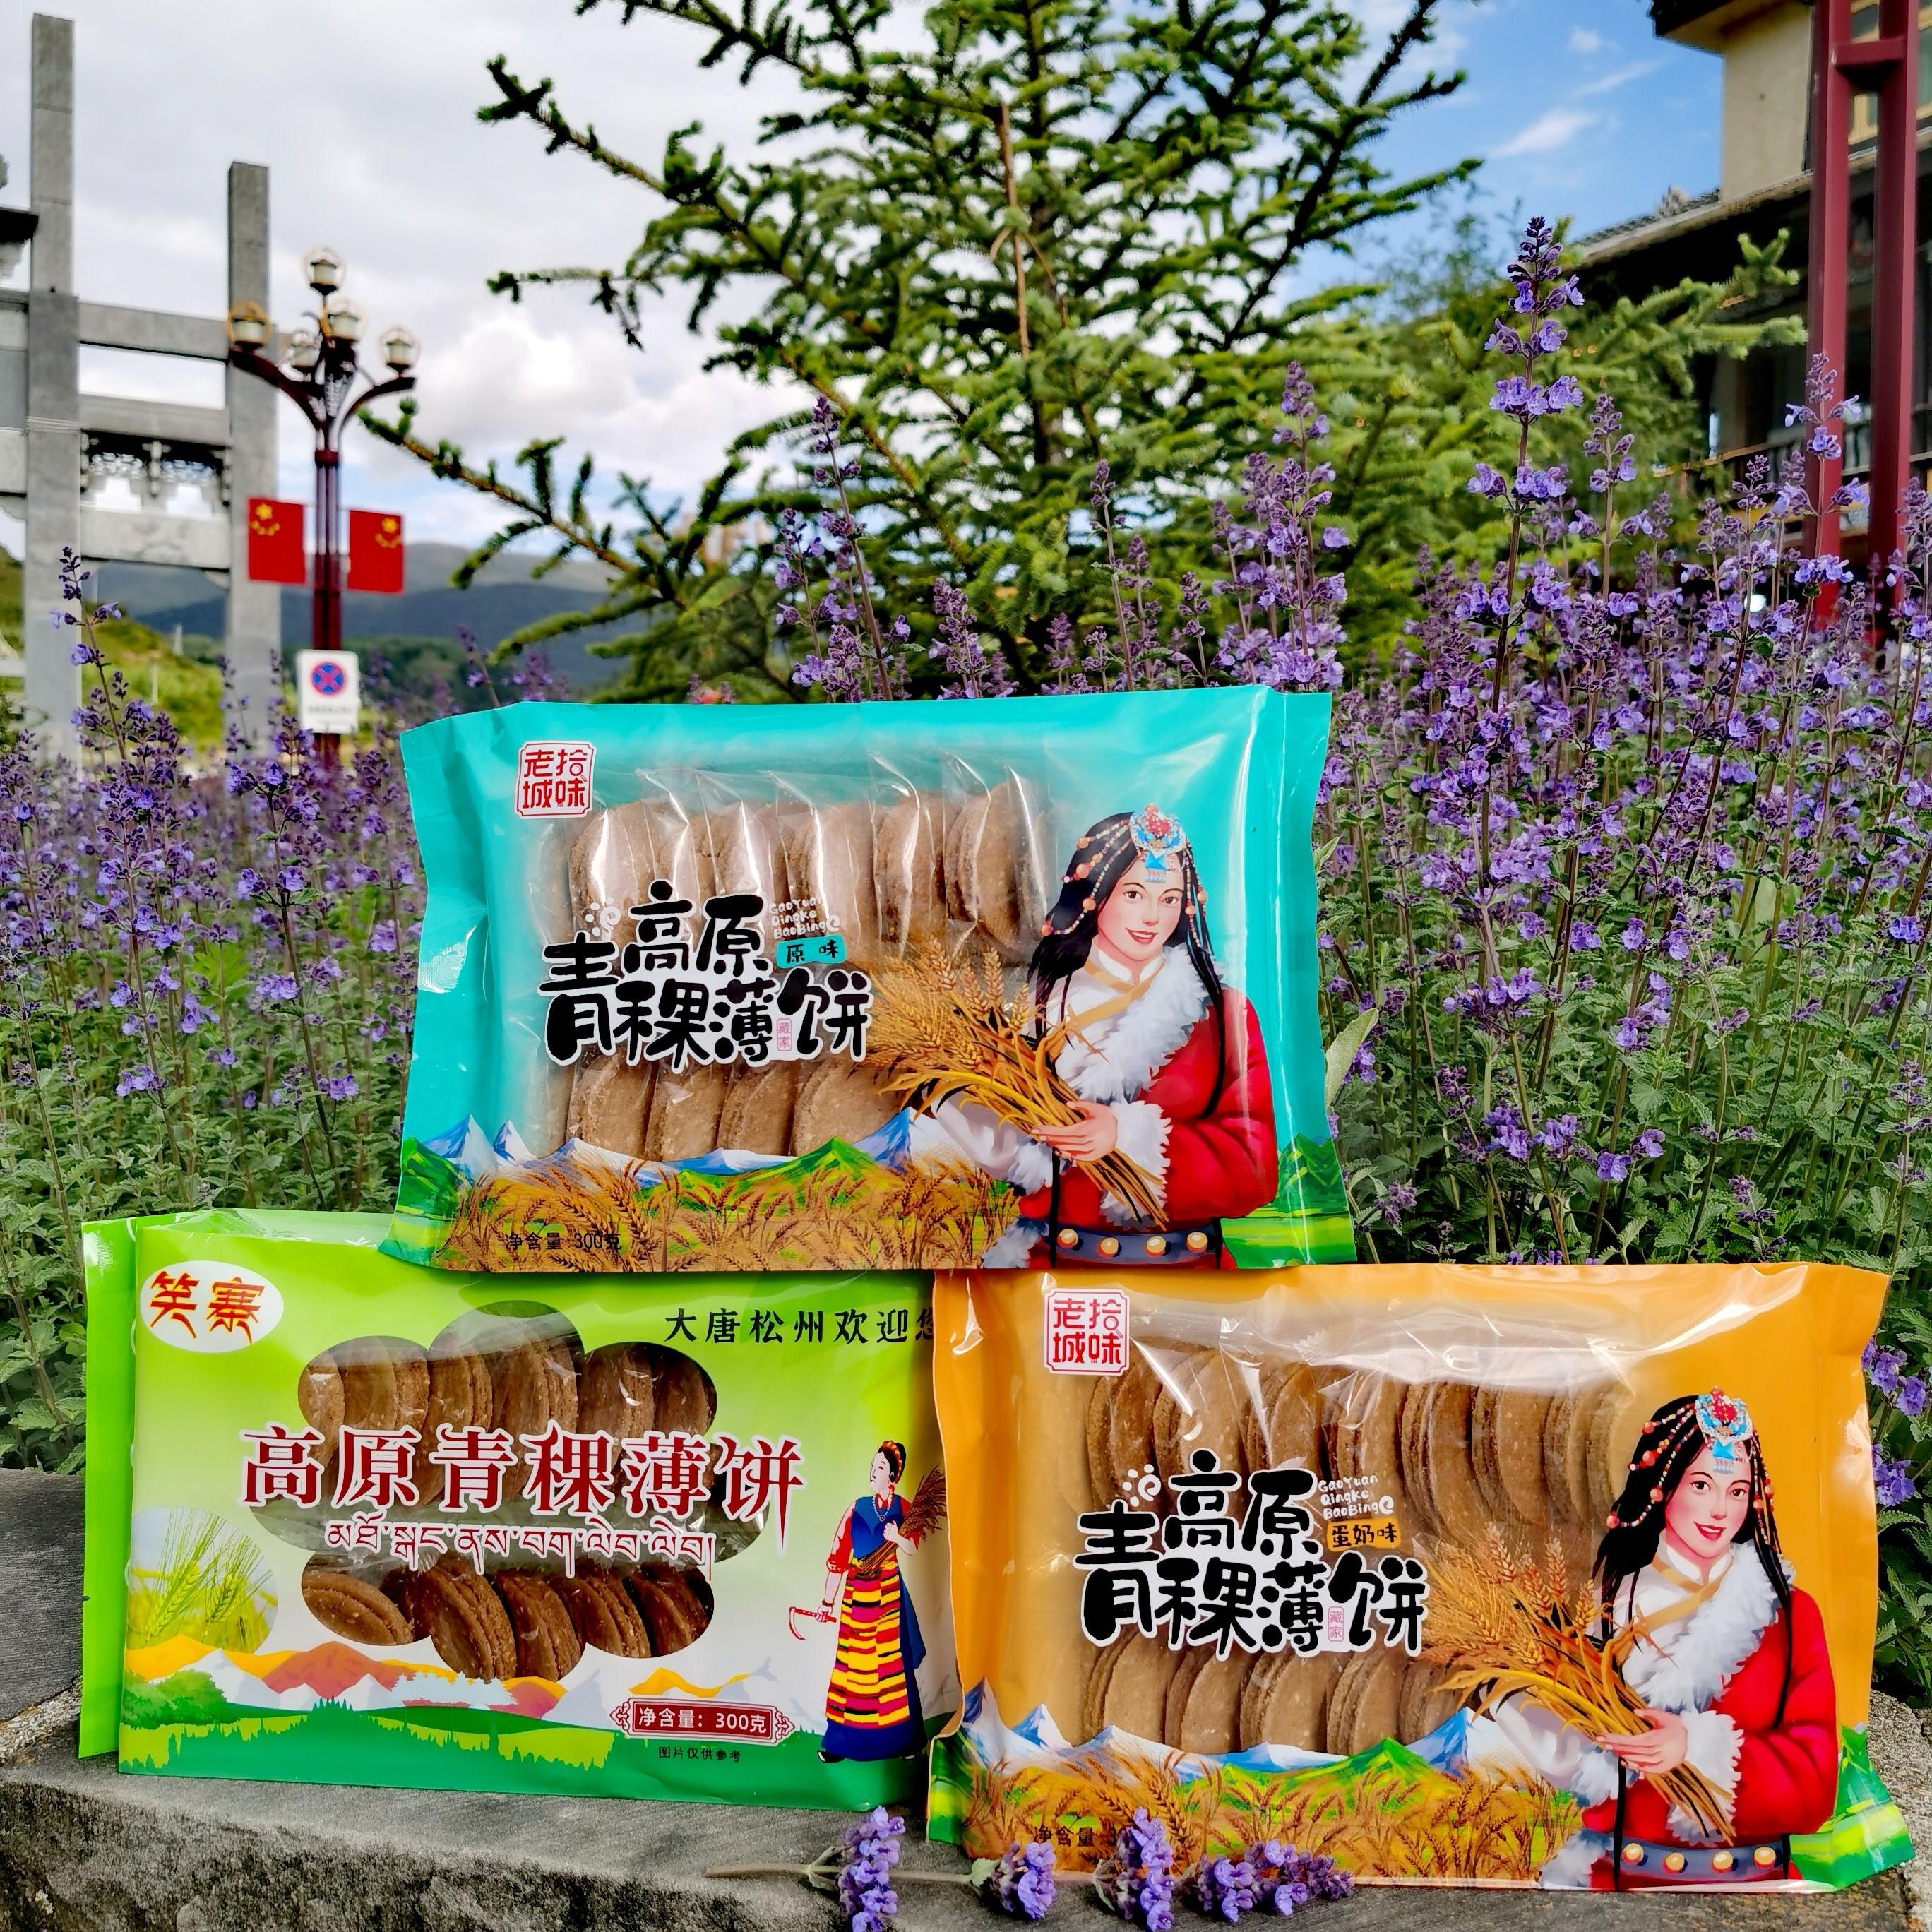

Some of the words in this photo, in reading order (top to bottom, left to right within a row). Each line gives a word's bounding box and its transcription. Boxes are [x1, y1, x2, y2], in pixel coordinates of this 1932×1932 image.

[622, 880, 770, 977] 高原
[539, 932, 871, 1070] 青稞薄饼
[242, 1424, 804, 1549] 高原青稞薄饼
[1164, 1449, 1320, 1556] 高原
[1318, 1475, 1379, 1493] GaoYuan
[1332, 1522, 1398, 1548] 蛋奶味
[1075, 1502, 1428, 1658] 青稞薄饼
[658, 1746, 741, 1763] 图片仅供参考
